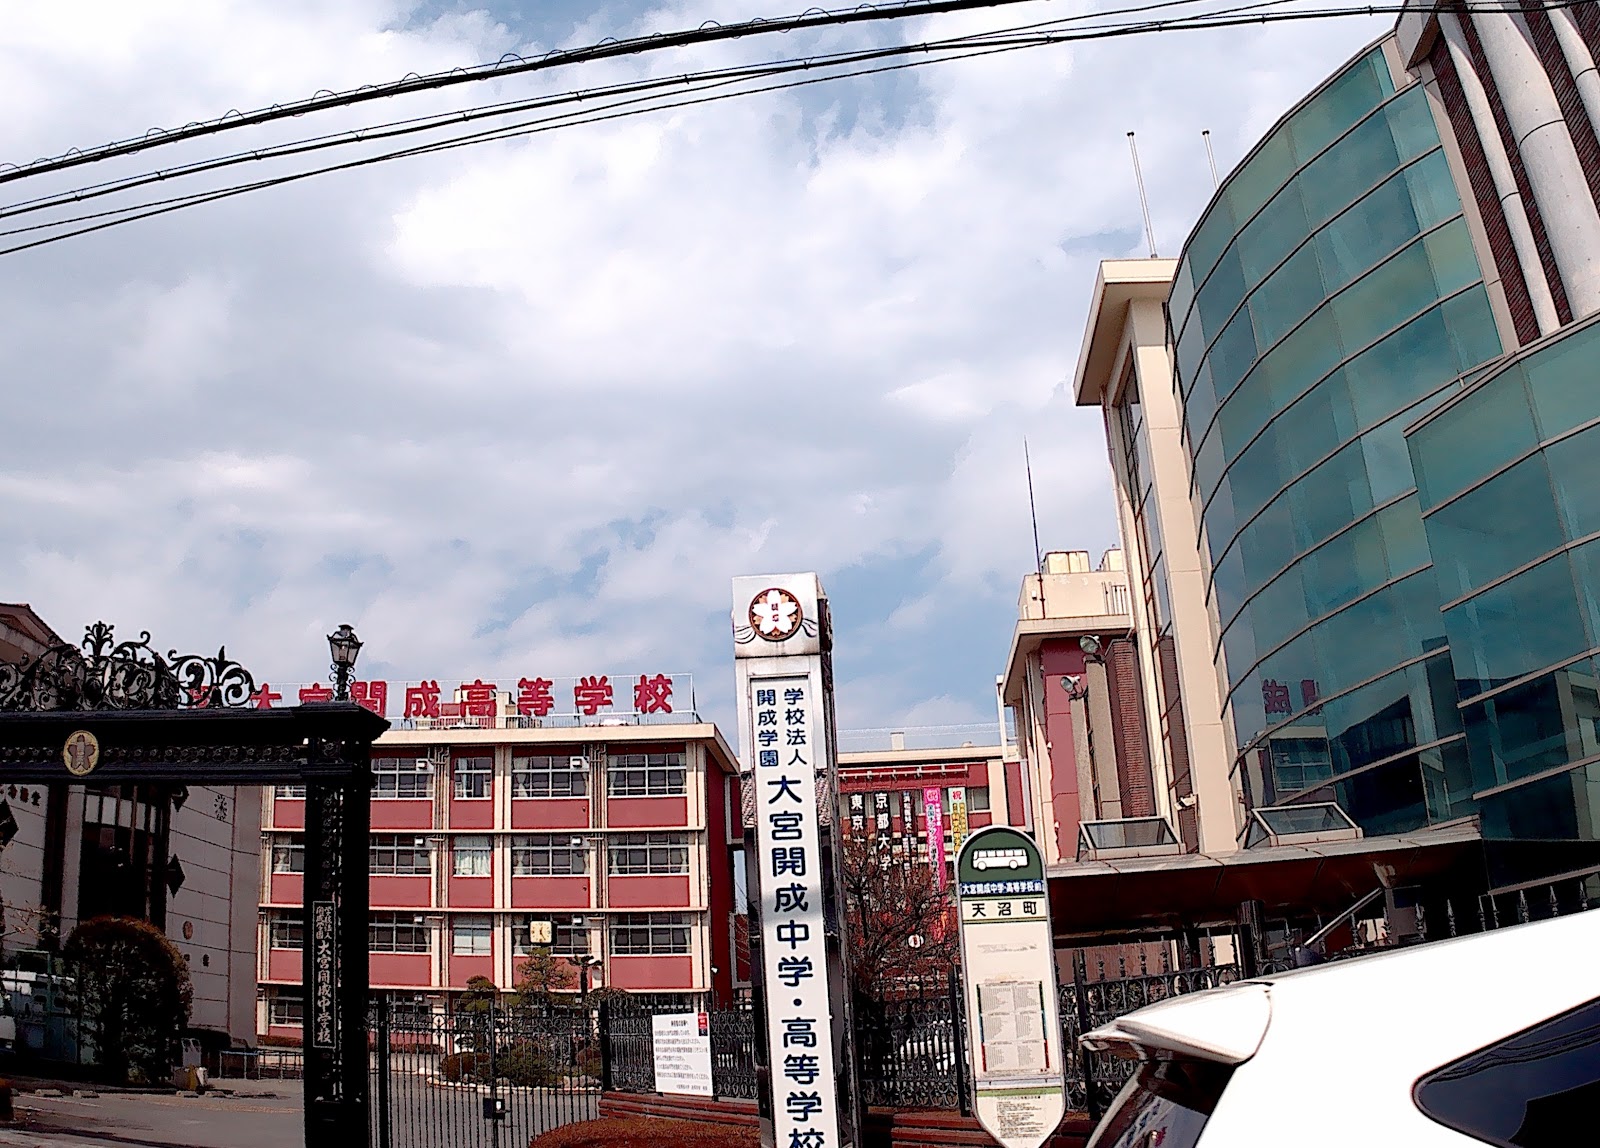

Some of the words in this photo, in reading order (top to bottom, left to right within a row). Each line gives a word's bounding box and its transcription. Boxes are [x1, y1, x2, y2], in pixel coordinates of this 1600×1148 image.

[756, 688, 779, 768] 開成学園
[784, 687, 808, 767] 学校法人
[874, 792, 892, 871] 京都大学
[952, 790, 962, 800] 祝
[324, 905, 334, 940] 学校法人
[971, 901, 1037, 918] 天沼町
[316, 940, 333, 1043] 大宮開成中学校
[767, 774, 825, 1148] 大宮開成中学・高等学校
